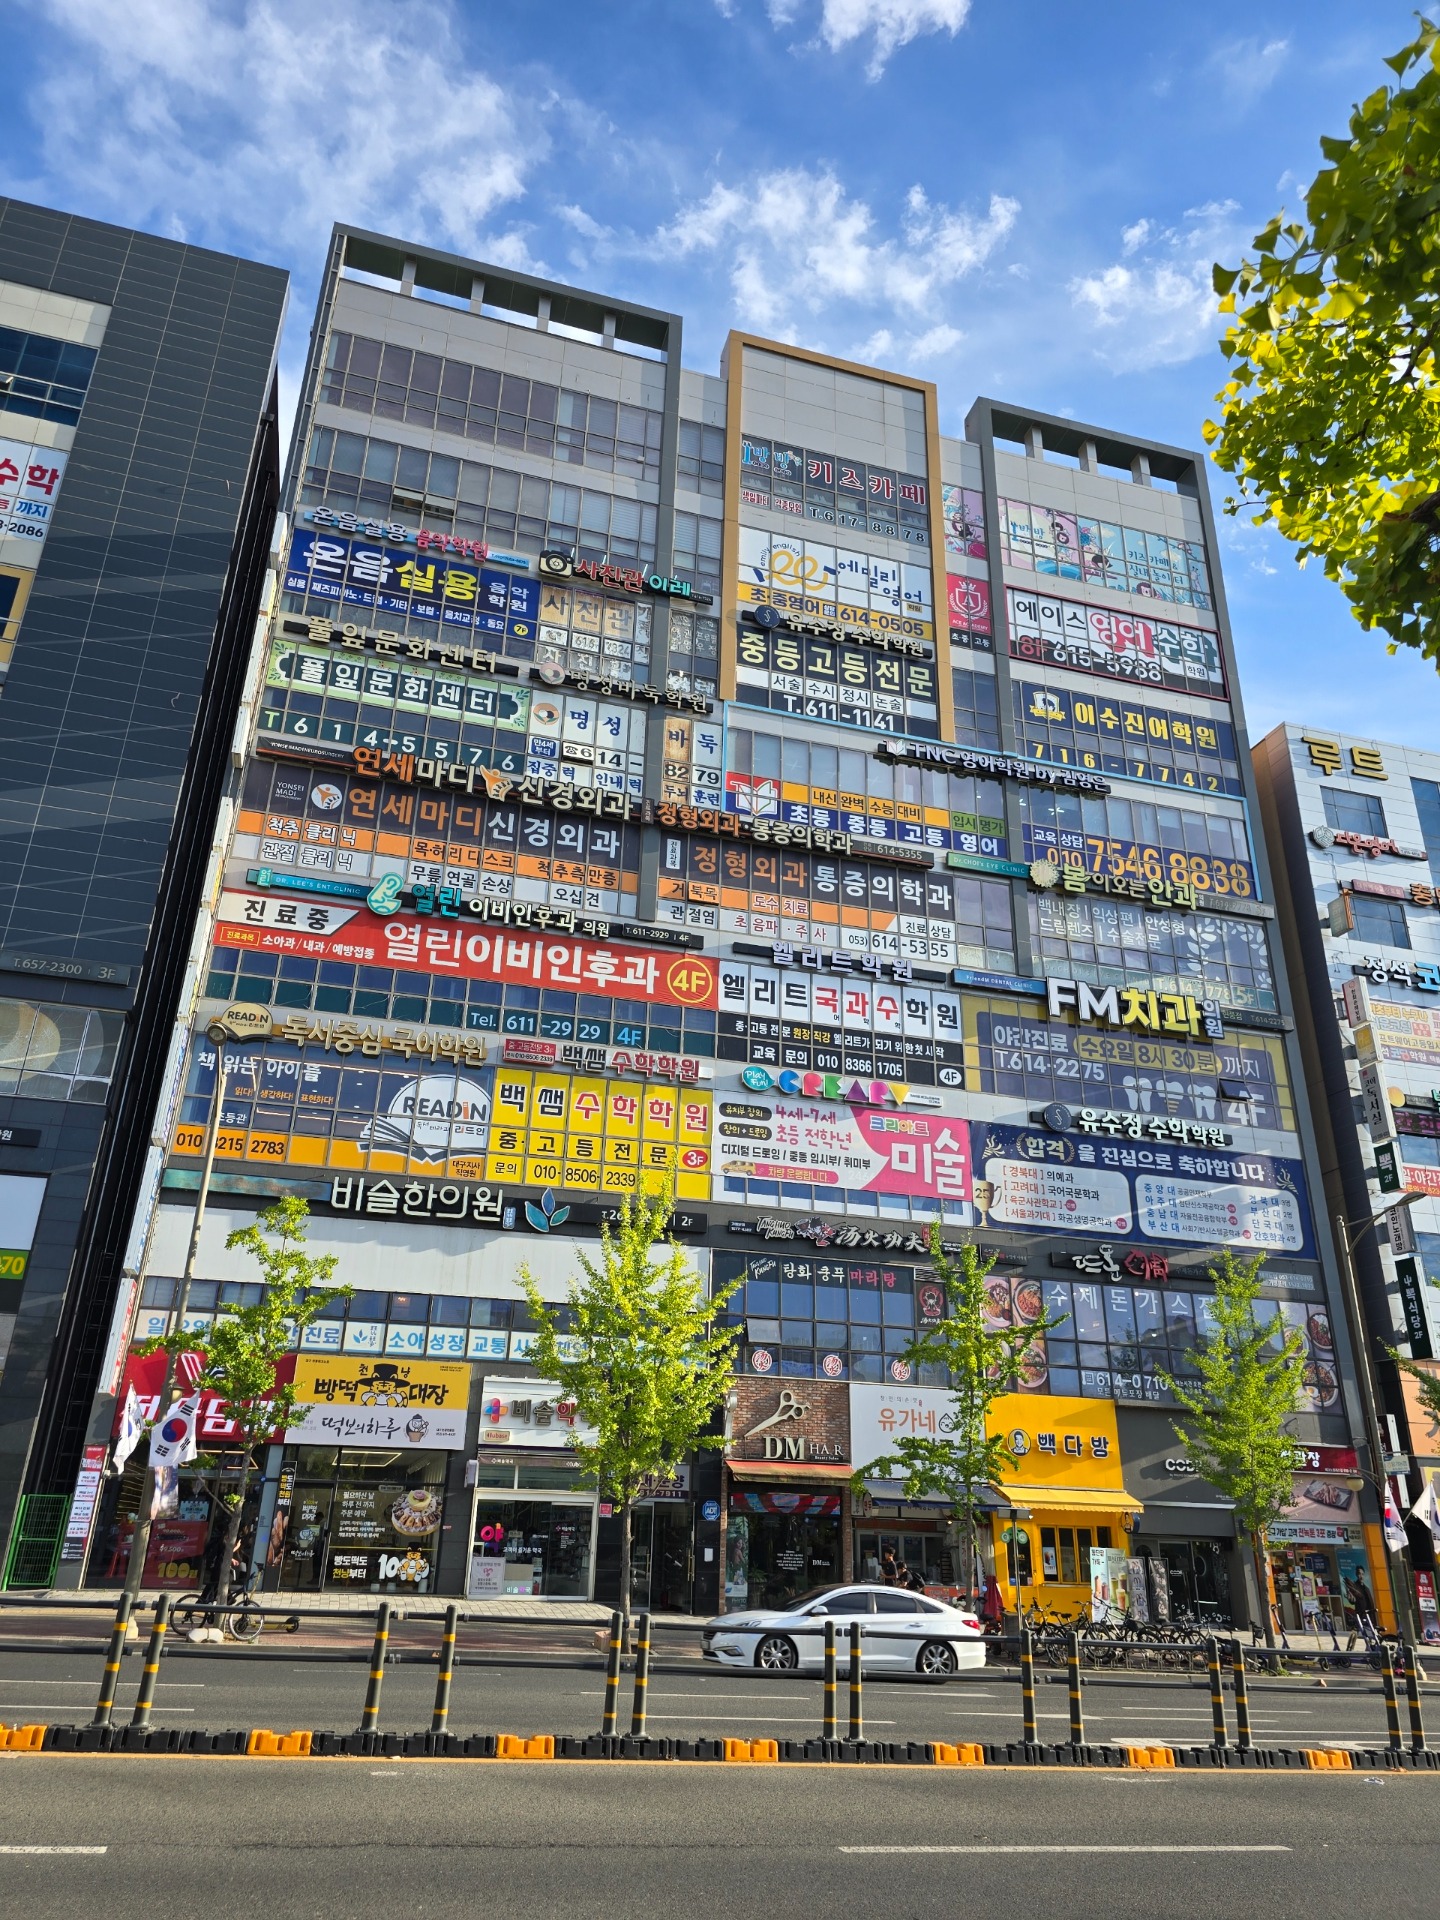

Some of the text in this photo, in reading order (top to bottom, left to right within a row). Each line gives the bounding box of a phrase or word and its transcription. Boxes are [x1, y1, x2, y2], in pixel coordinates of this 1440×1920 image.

[416, 529, 489, 562] 음악학원
[576, 559, 692, 597] 사진관 이레
[838, 560, 896, 589] 에밀리
[883, 586, 923, 607] 영어
[786, 612, 845, 641] 유수정
[840, 607, 924, 636] 614-0505
[1016, 600, 1086, 632] 에이스
[1090, 612, 1150, 655] 영어
[307, 615, 498, 674] 풀잎문화센터
[300, 656, 494, 713] 풀잎문화센터
[1187, 666, 1206, 677] 학원
[773, 674, 902, 711] 서술 수시 정시 논술
[569, 709, 719, 754] 명성 바둑
[1075, 701, 1218, 750] 이수진어학원
[909, 743, 957, 764] TNC
[1035, 765, 1057, 784] by
[1302, 736, 1389, 780] 루트
[351, 745, 476, 793] 연세마디
[517, 775, 634, 822] 신경외과
[812, 790, 837, 804] 내신
[840, 796, 865, 811] 완벽
[897, 805, 921, 821] 대비
[268, 817, 357, 846] 척추 클리닉
[349, 788, 482, 836] 연세마디
[488, 811, 620, 859] 신경외과
[790, 804, 831, 828] 초등
[847, 814, 888, 838] 중등
[904, 824, 944, 847] 고등
[959, 833, 999, 857] 영어
[1034, 825, 1084, 849] 교육 상담
[262, 842, 354, 871] 관절 클리닉
[411, 865, 512, 895] 무릎 연골 손상
[694, 845, 952, 911] 정형외과 통증의학과
[244, 899, 329, 929] 진료중
[411, 884, 610, 939] 열린 이비인후과 의원
[384, 921, 707, 995] 열린이비인후과 4F
[771, 941, 913, 984] 엘리트학원
[1364, 956, 1413, 988] 정석
[281, 1013, 487, 1066] 독서중심 국어학원
[471, 1012, 642, 1046] Tel. 4F
[994, 1025, 1069, 1053] 야간진료
[562, 1044, 700, 1083] 백쌤 수학학원
[752, 1046, 957, 1083] 교육 문의 010 8366 1705 4F
[500, 1083, 708, 1132] 백쌤수학학원
[775, 1124, 800, 1144] 초등
[870, 1115, 930, 1137] 크리아트
[1079, 1108, 1142, 1139] 유수정
[176, 1132, 285, 1155] 010 2783
[721, 1143, 781, 1160] 디지털 드로잉
[1026, 1136, 1265, 1182] 합격 을 진심으로 축하합니다
[494, 1162, 517, 1175] 문의
[891, 1127, 966, 1197] 미술
[1009, 1165, 1075, 1183] 경북대 의예과
[331, 1176, 504, 1222] 비슬한의원
[1010, 1181, 1100, 1201] 고려대 국어국문학과
[783, 1261, 897, 1288] 탕화쿵푸 마라탕
[305, 1327, 340, 1345] 진료
[408, 1383, 450, 1406] 대장
[877, 1406, 937, 1434] 유가네
[763, 1436, 806, 1461] DM
[1036, 1432, 1110, 1459] 빽다방
[1165, 1458, 1201, 1472] COD
